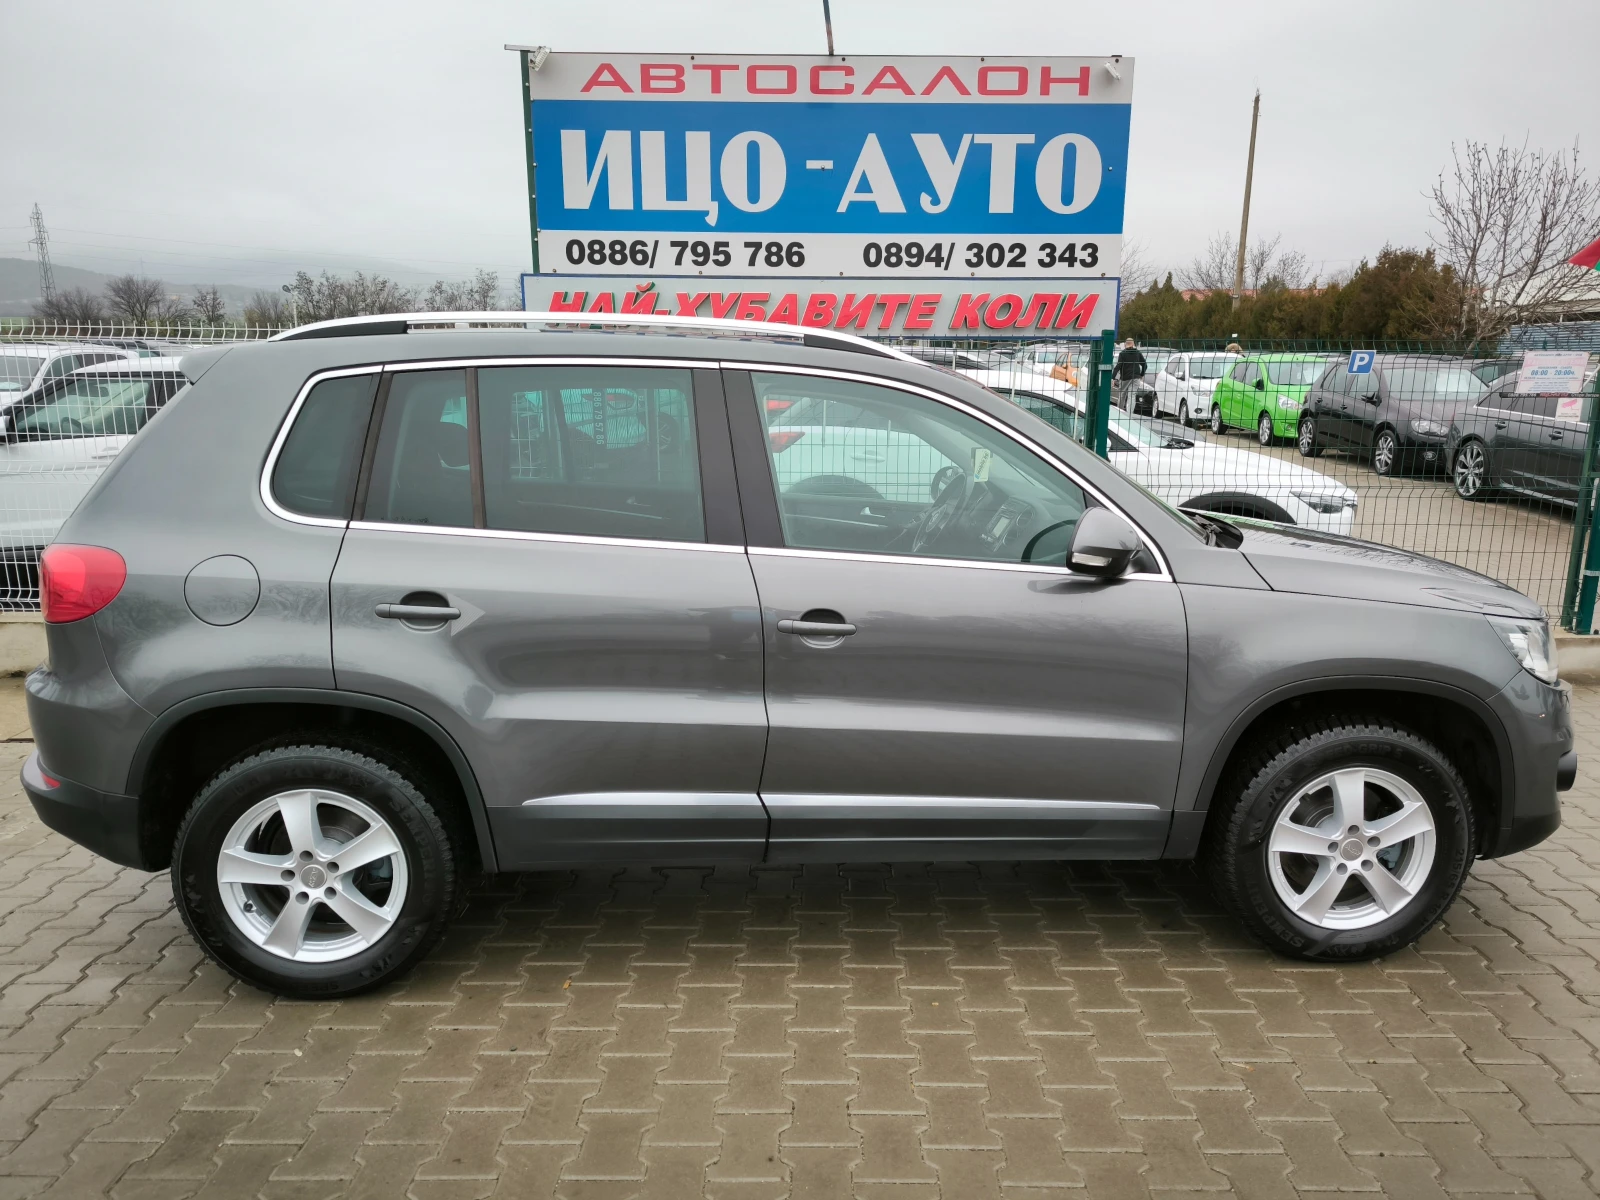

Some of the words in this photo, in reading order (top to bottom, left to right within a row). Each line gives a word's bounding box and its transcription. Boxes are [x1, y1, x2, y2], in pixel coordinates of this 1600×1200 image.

[580, 62, 1090, 96] АВТОСАЛОН
[670, 240, 731, 267] 795
[744, 241, 805, 267] 786
[965, 242, 1026, 268] 302
[1038, 242, 1099, 268] 343
[949, 293, 1100, 330] КОЛИ
[1352, 354, 1369, 372] P
[594, 410, 603, 420] 79
[595, 422, 604, 432] 57
[596, 434, 605, 445] 86
[1246, 880, 1305, 948] SEMPERIT
